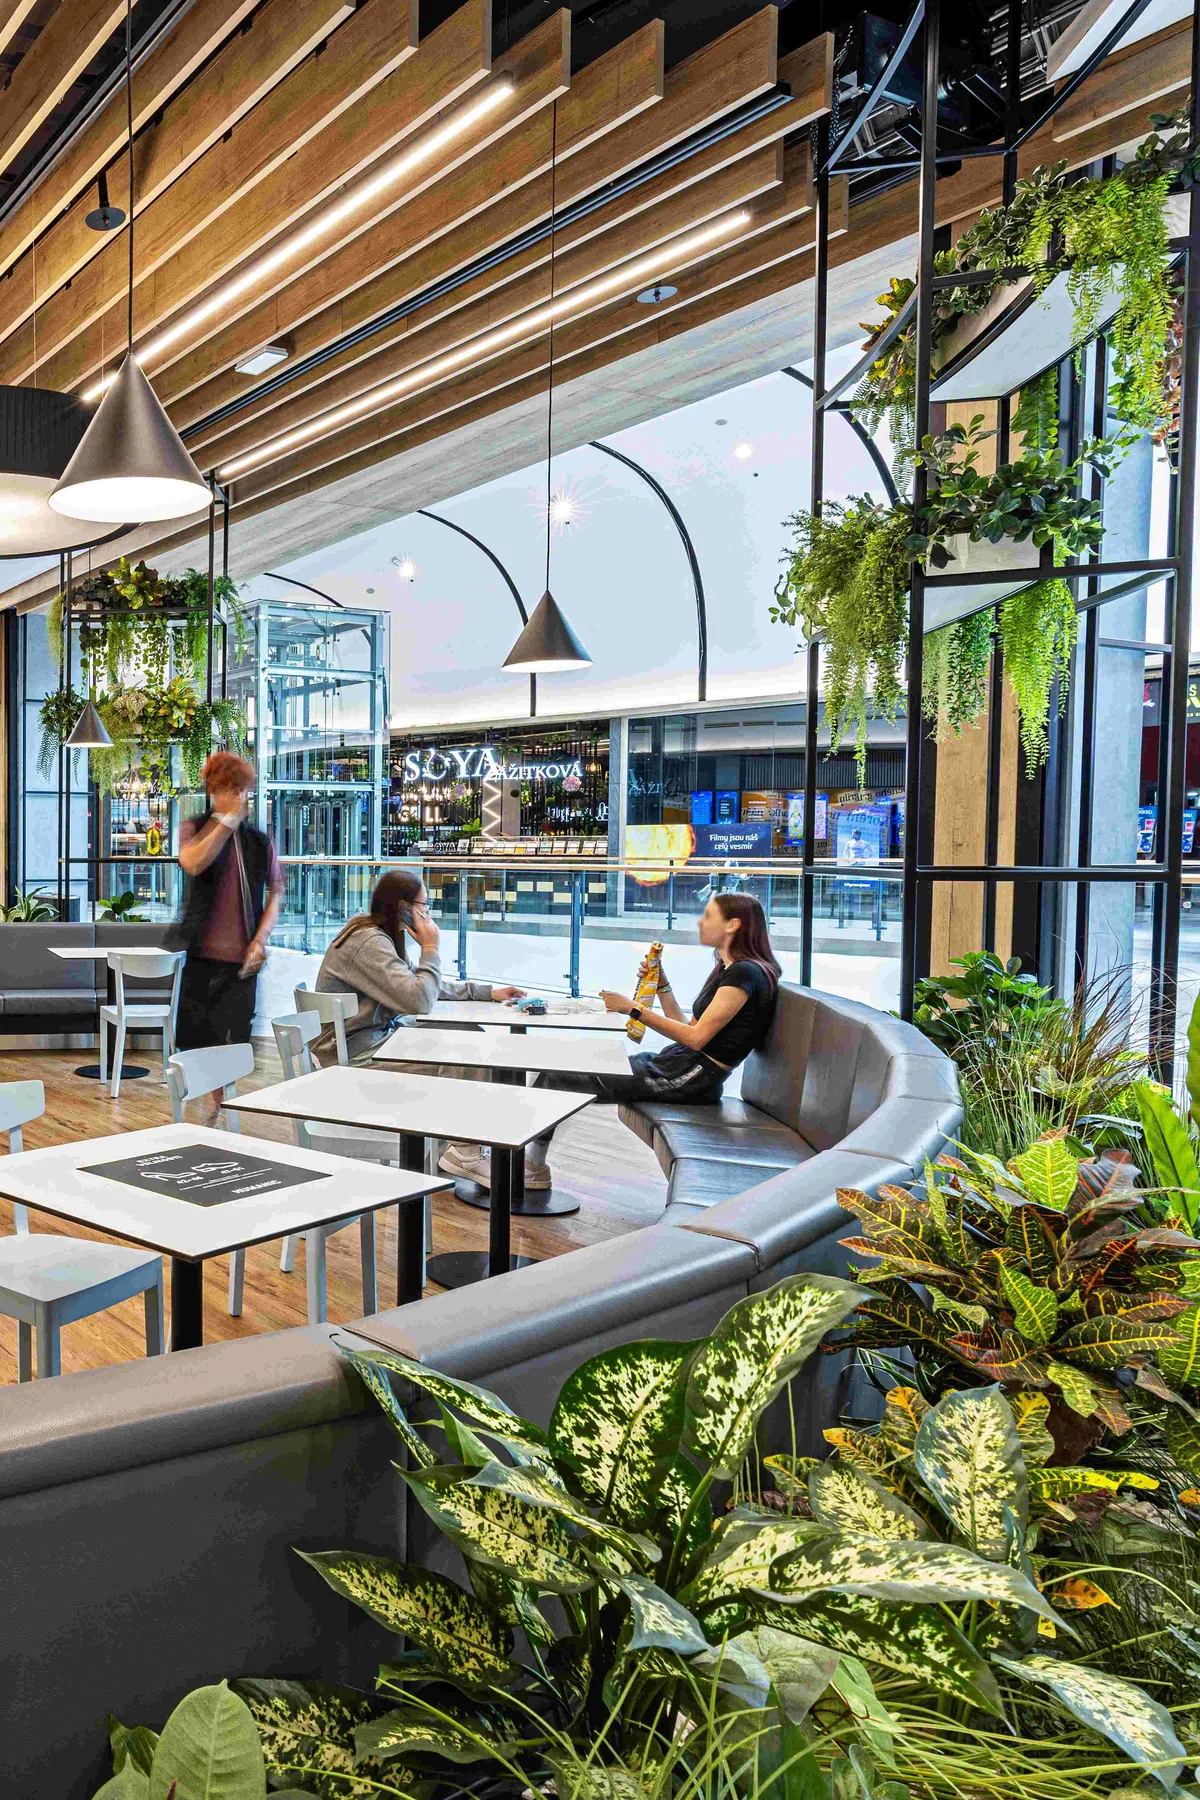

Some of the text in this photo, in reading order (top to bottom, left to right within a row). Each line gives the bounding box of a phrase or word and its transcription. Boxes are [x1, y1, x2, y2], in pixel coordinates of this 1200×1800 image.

[709, 833, 759, 843] Filmy jsou náš
[714, 842, 753, 852] celý vesmír
